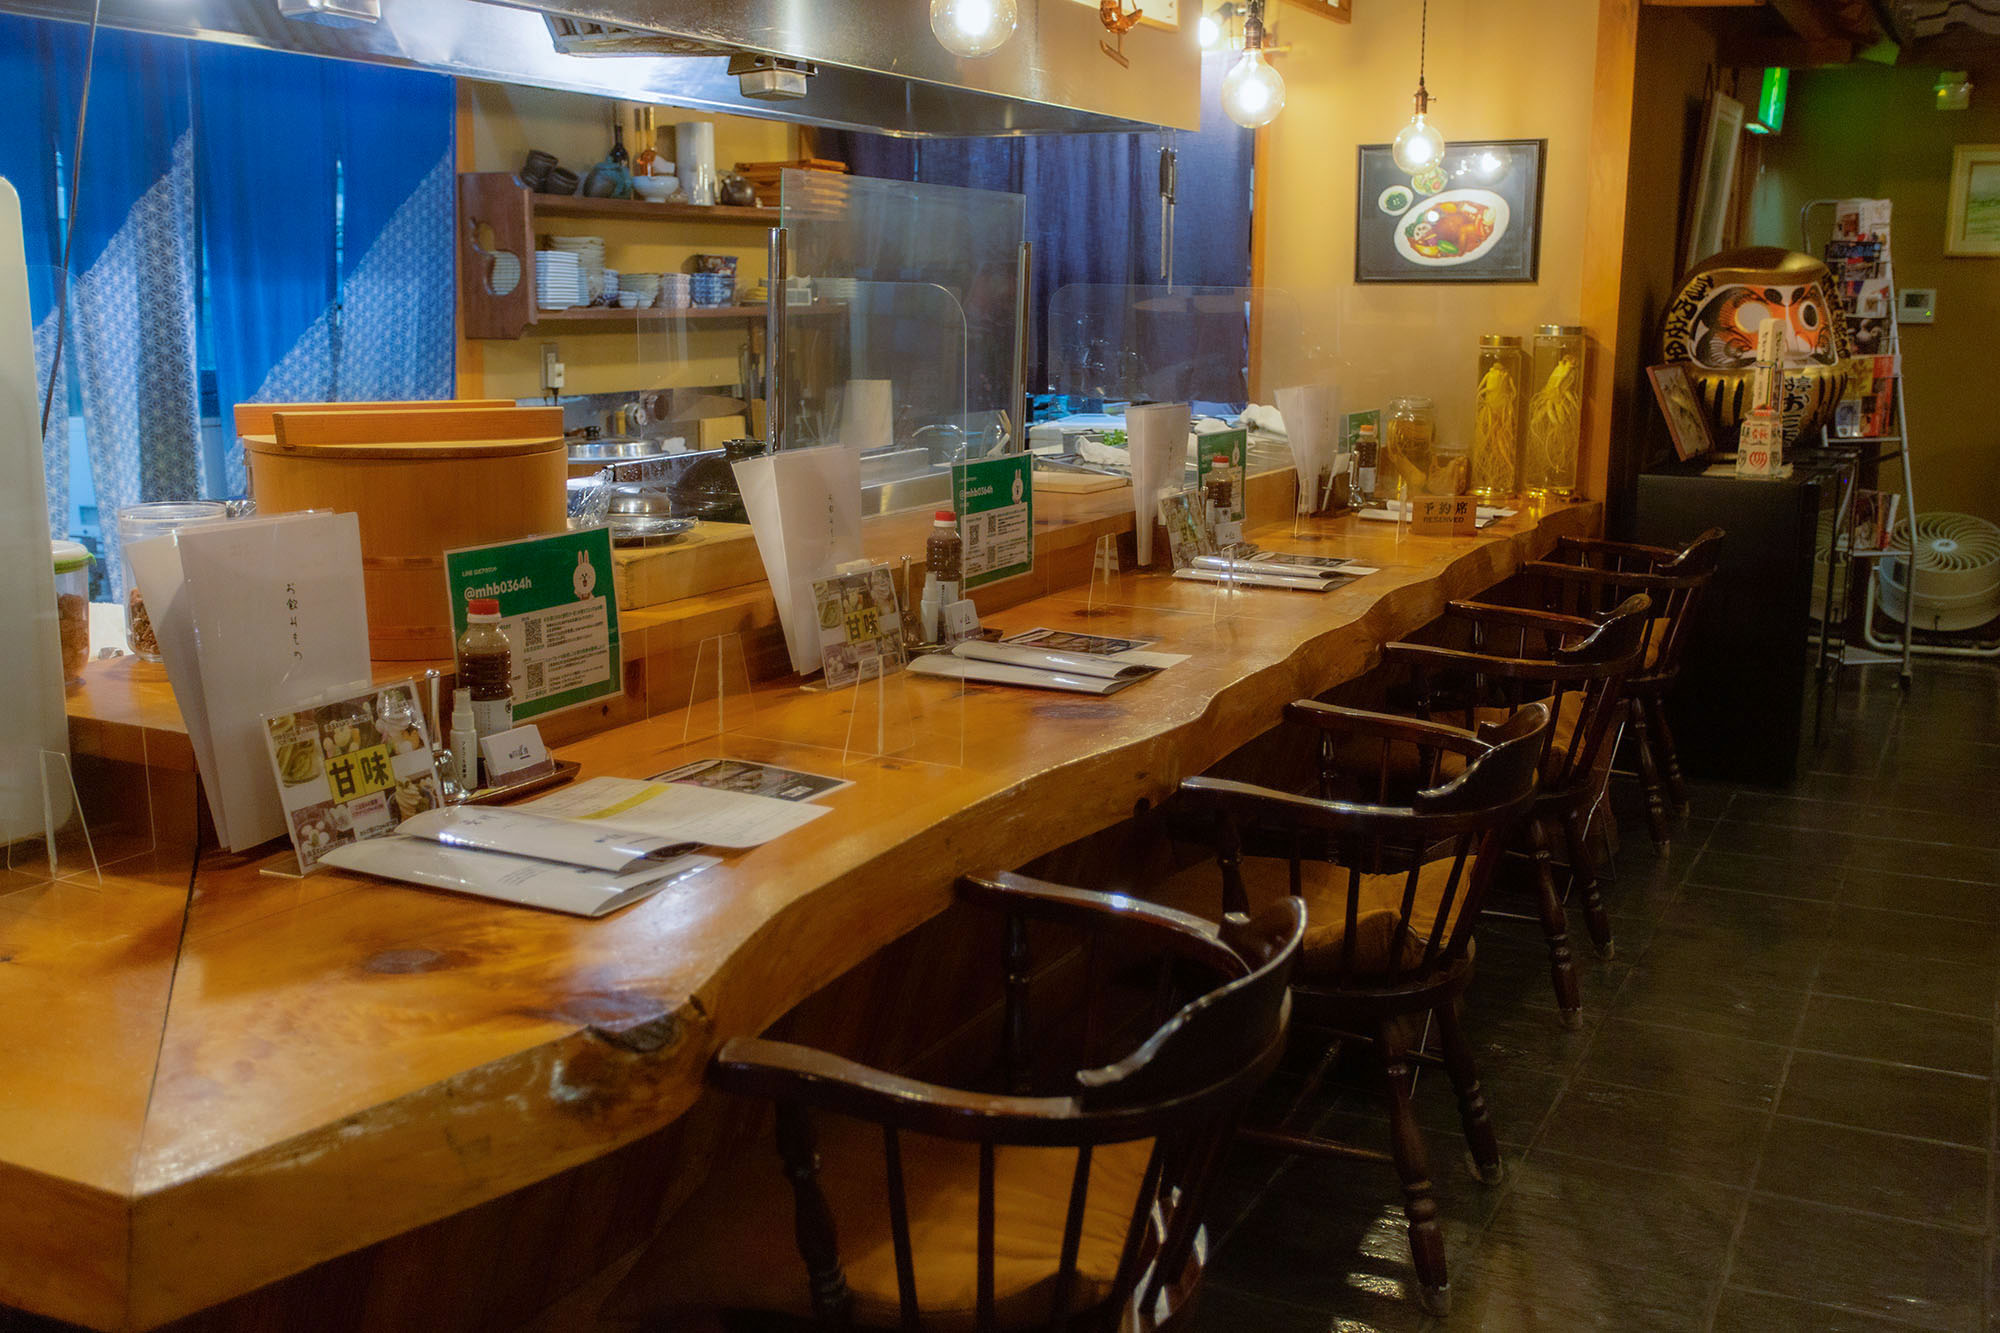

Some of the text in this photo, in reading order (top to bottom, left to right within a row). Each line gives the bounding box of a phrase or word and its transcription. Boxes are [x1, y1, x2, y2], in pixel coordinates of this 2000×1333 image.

[1424, 502, 1468, 514] 予約席
[464, 576, 533, 601] @mhb0364h
[846, 613, 879, 641] 甘味
[329, 751, 390, 797] 甘味
